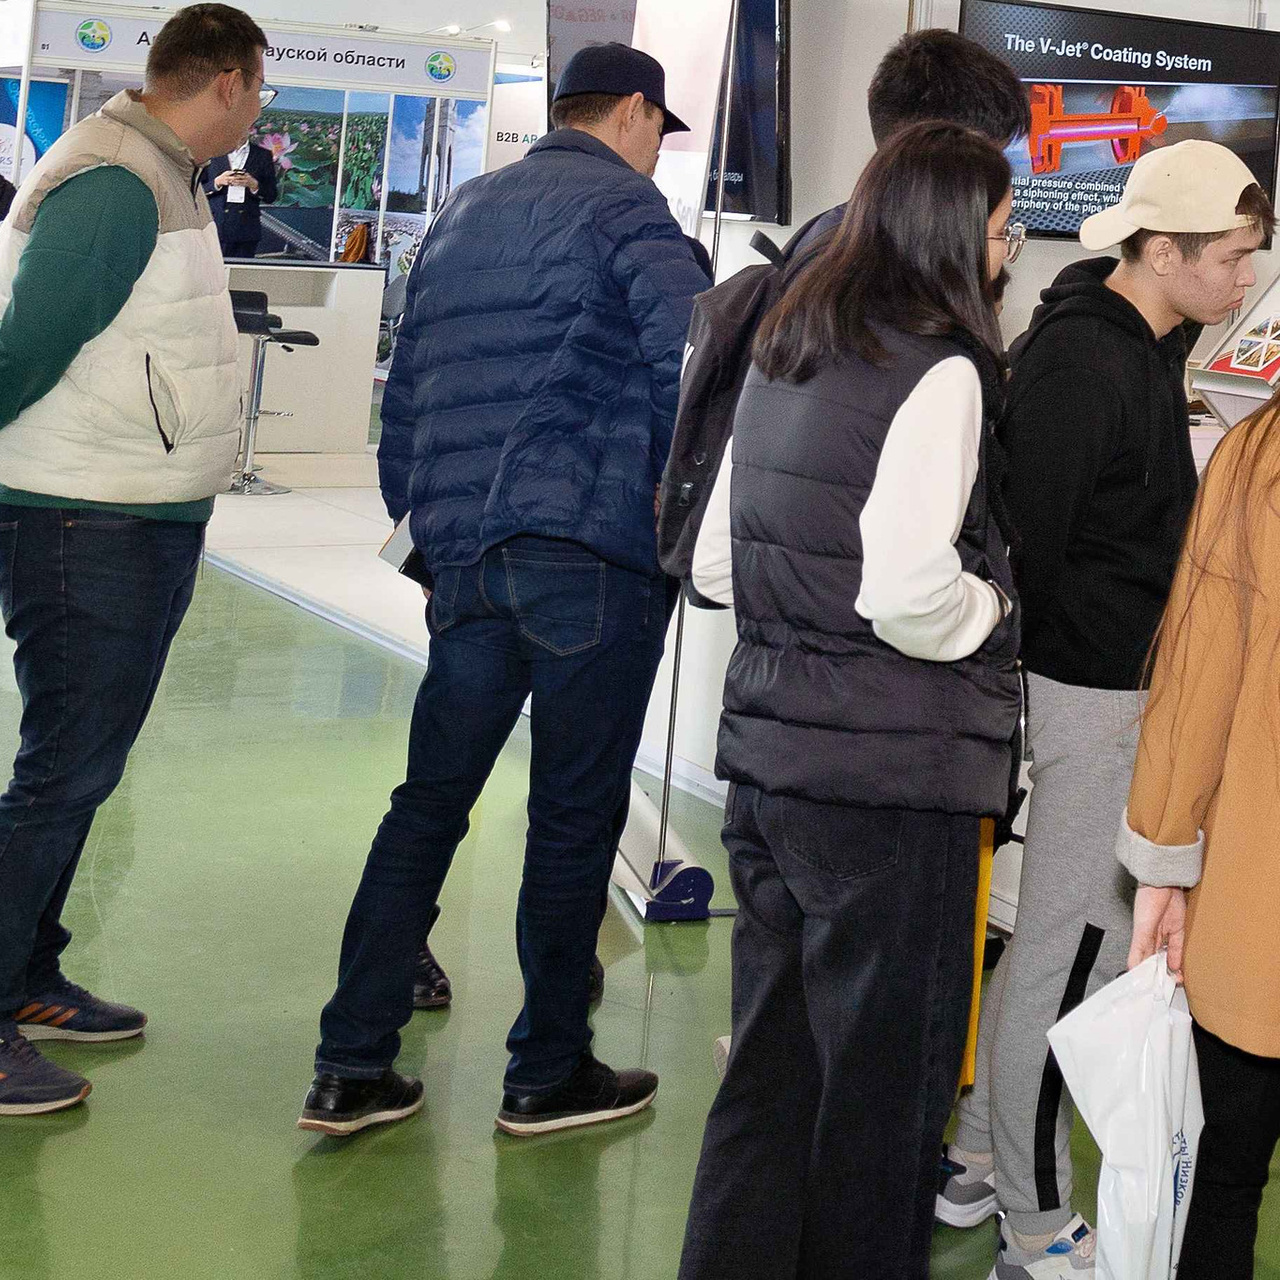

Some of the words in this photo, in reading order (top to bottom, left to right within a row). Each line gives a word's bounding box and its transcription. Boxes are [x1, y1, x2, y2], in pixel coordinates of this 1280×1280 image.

[262, 45, 328, 63] ауской
[333, 49, 406, 69] области
[1004, 33, 1035, 52] The
[1090, 43, 1151, 68] Coating
[1155, 51, 1212, 71] System
[496, 131, 519, 143] B2B
[1031, 178, 1073, 189] pressure
[1075, 180, 1120, 192] combined
[1014, 189, 1020, 197] a
[1023, 188, 1069, 201] siphoning
[1071, 192, 1100, 203] effect,
[1011, 199, 1050, 211] eriphery
[1053, 202, 1063, 211] of
[1065, 202, 1079, 212] the
[1082, 203, 1102, 214] pipe
